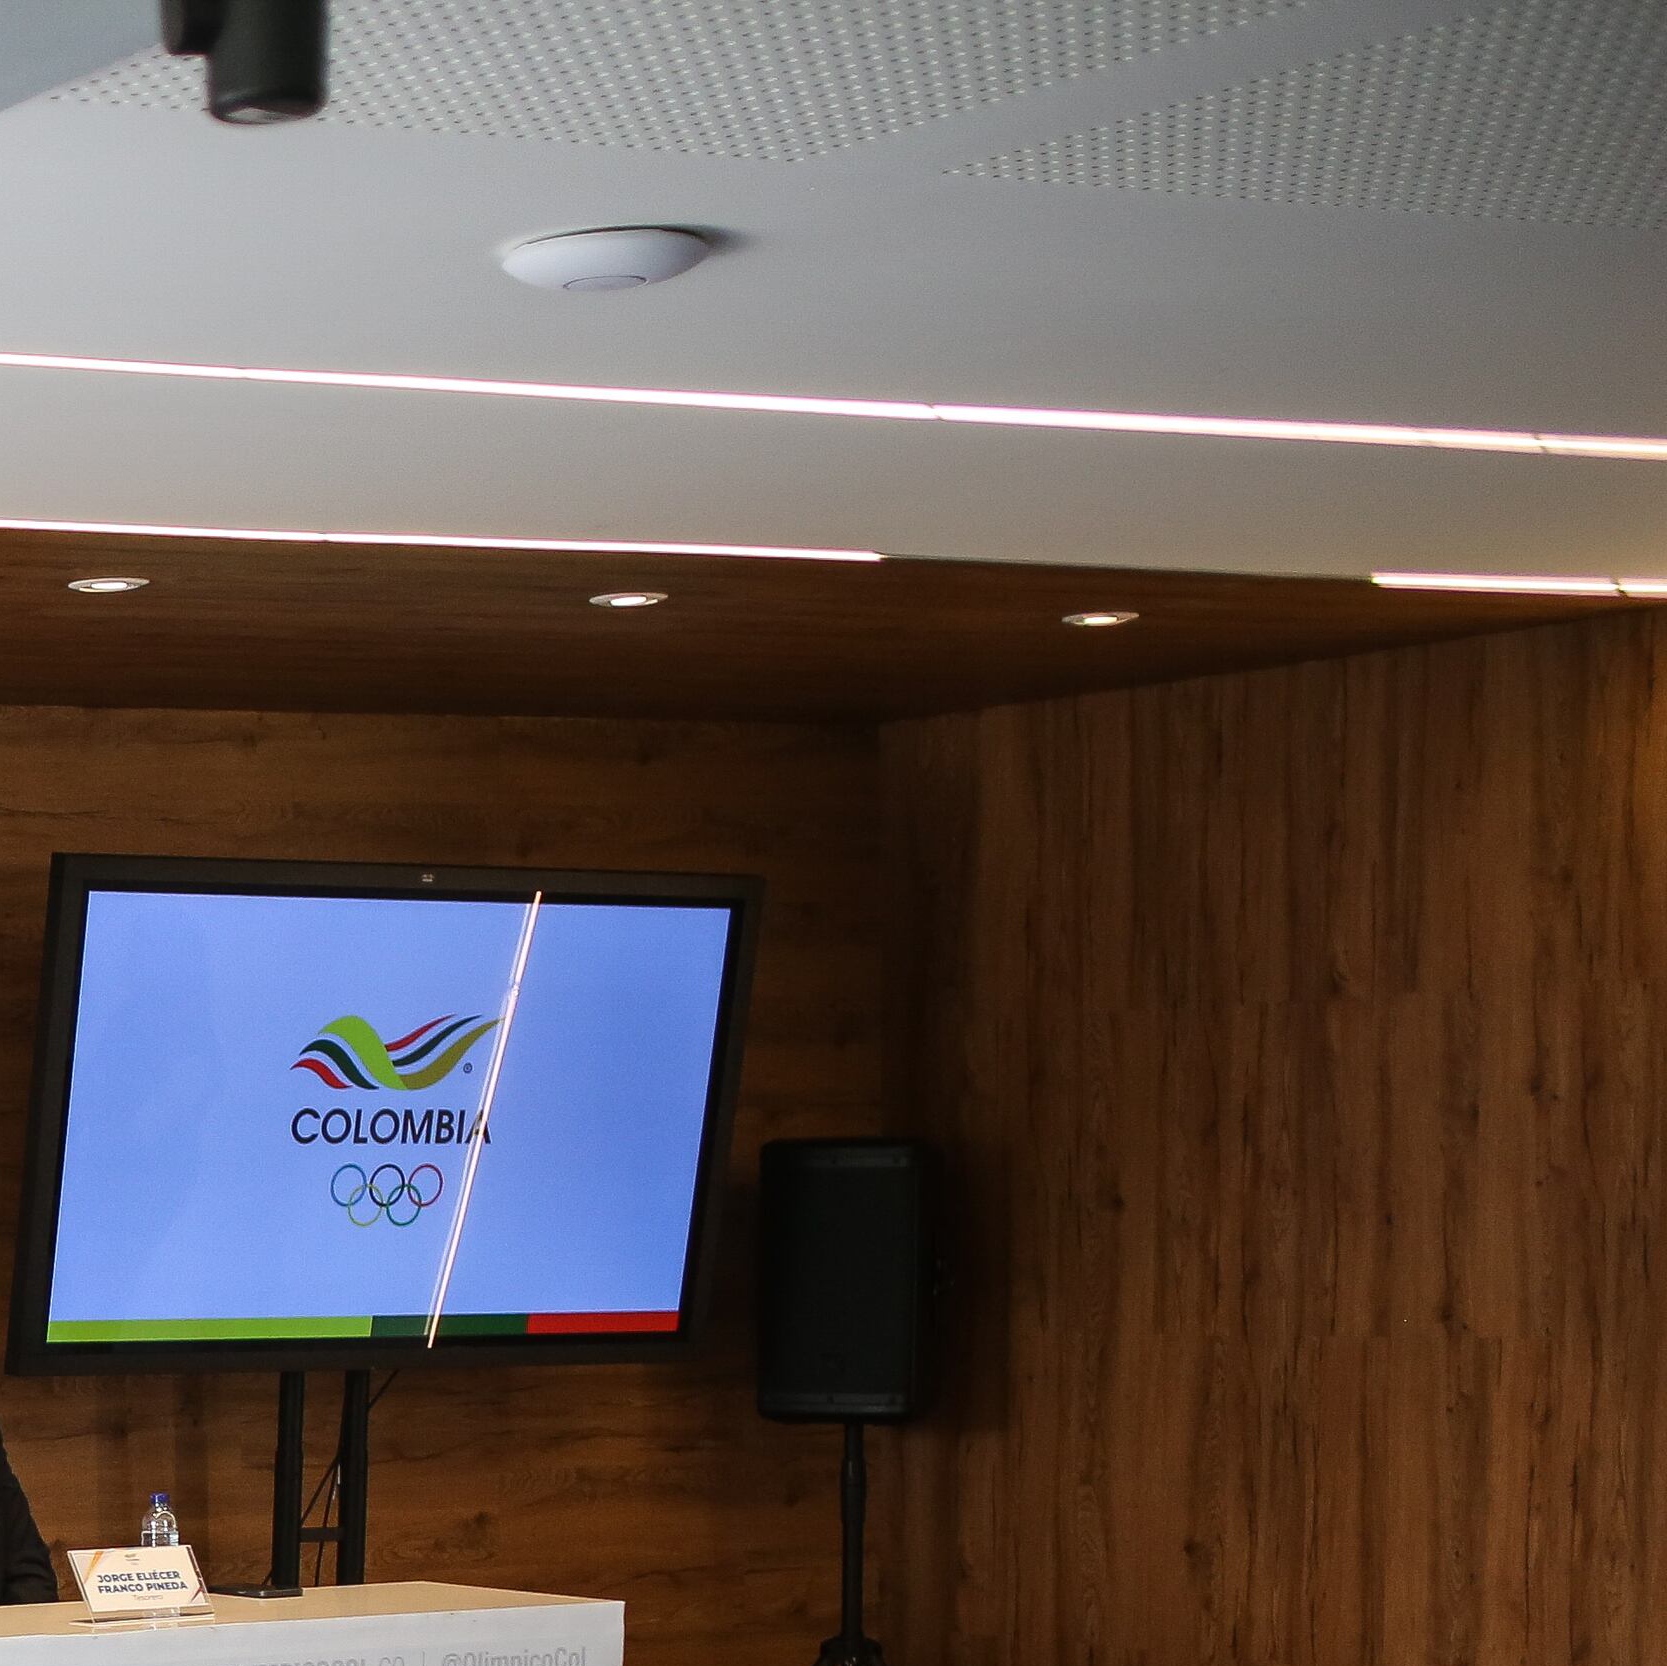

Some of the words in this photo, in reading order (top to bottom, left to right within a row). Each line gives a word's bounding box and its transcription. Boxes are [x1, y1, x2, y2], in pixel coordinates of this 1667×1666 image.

[291, 1108, 491, 1144] COLOMBIA
[97, 1573, 134, 1584] JORGE
[137, 1570, 181, 1581] ELIÉCER
[97, 1584, 144, 1594] FRANCO
[147, 1581, 188, 1592] PINEDA
